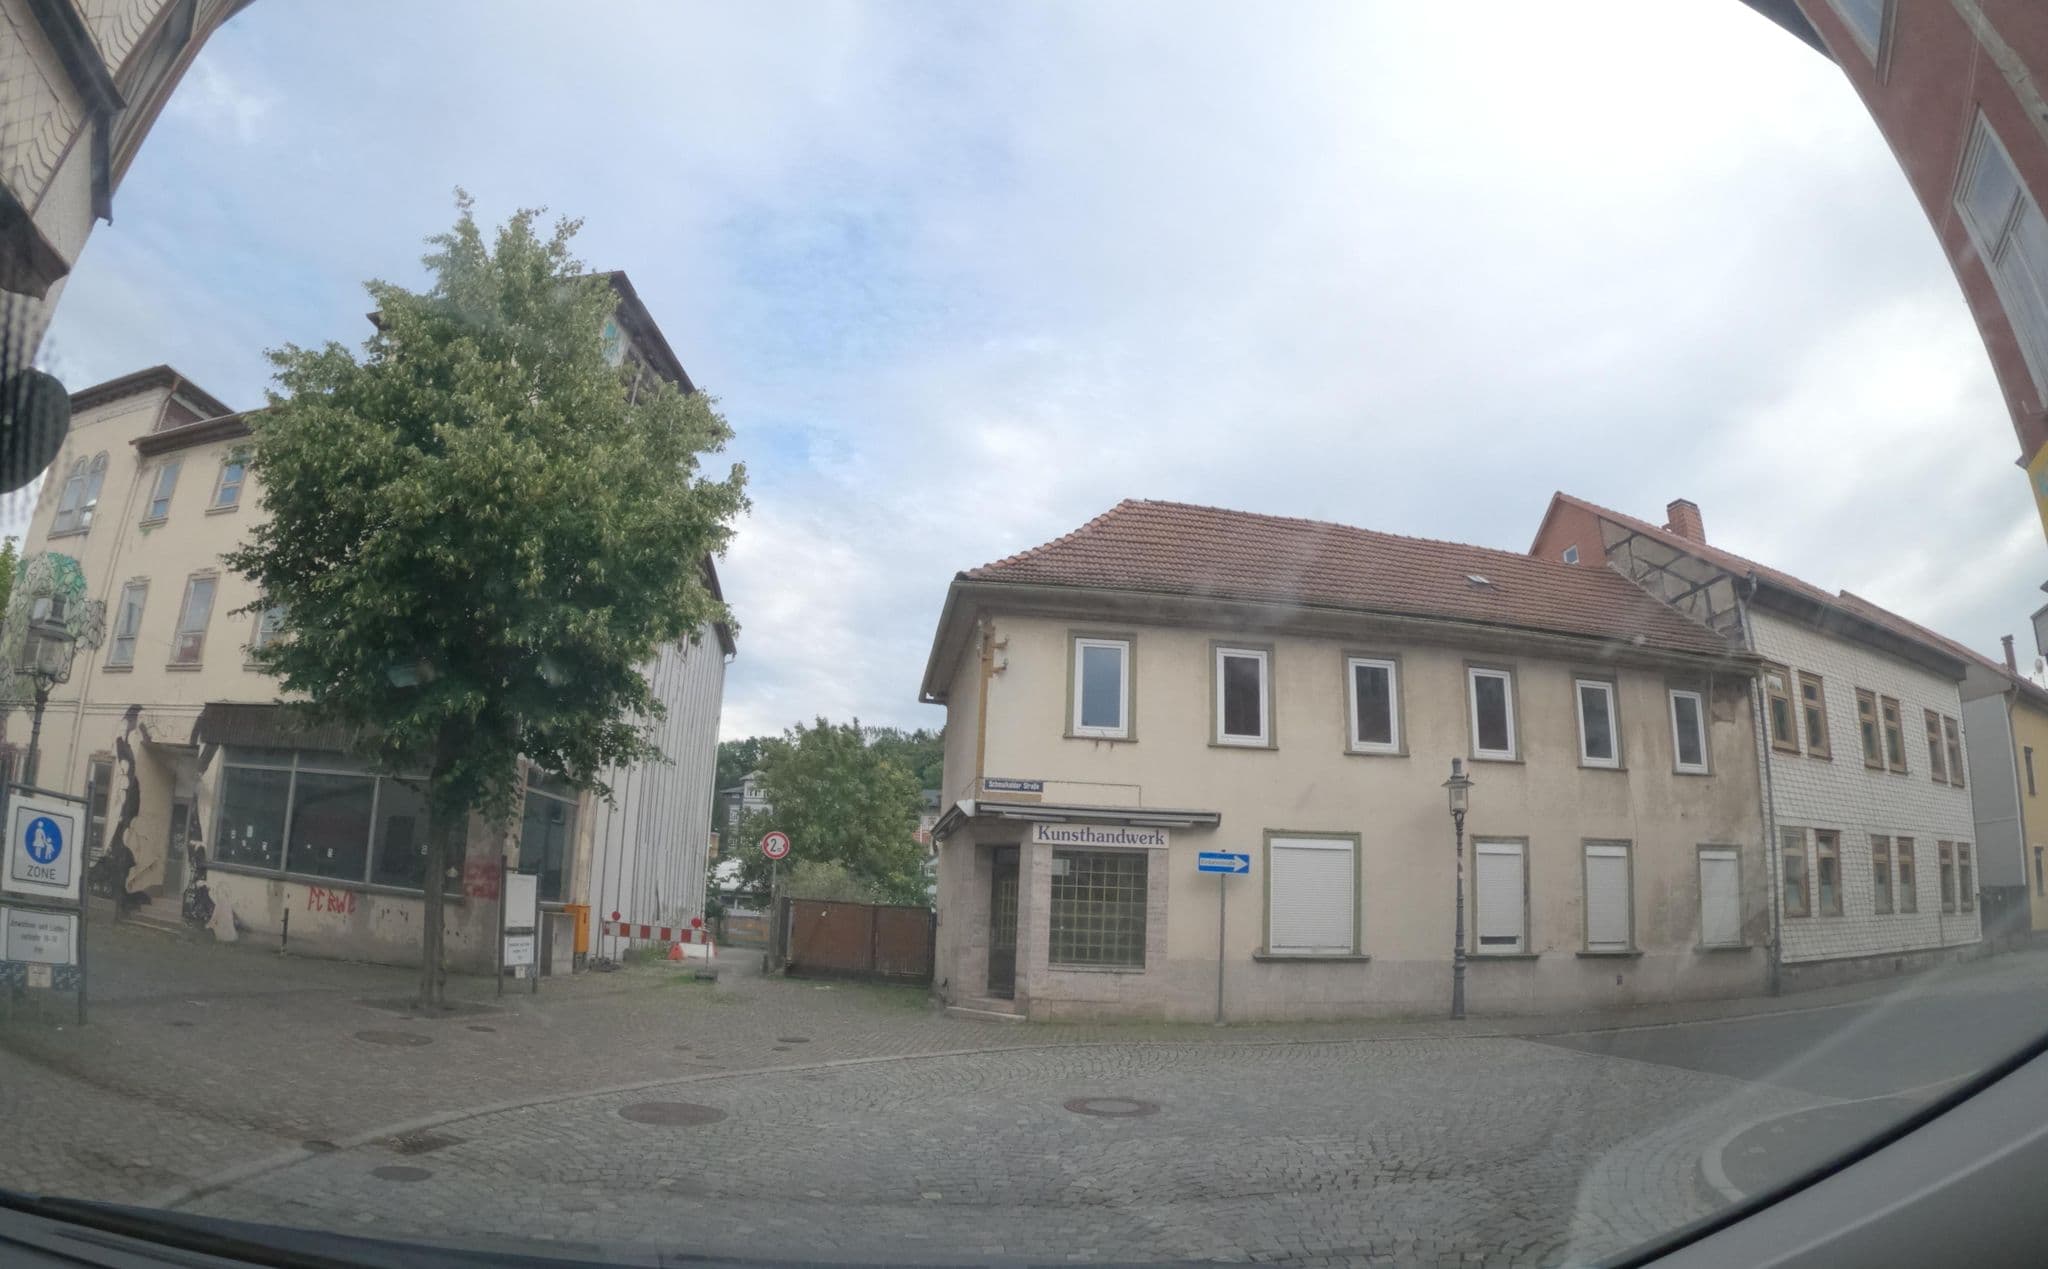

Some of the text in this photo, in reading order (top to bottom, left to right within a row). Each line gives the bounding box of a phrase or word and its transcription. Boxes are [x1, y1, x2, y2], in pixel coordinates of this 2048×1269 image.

[1023, 782, 1040, 790] Straße
[1038, 825, 1165, 845] Kunsthandwerk
[770, 838, 777, 852] 2
[27, 864, 57, 880] ZONE
